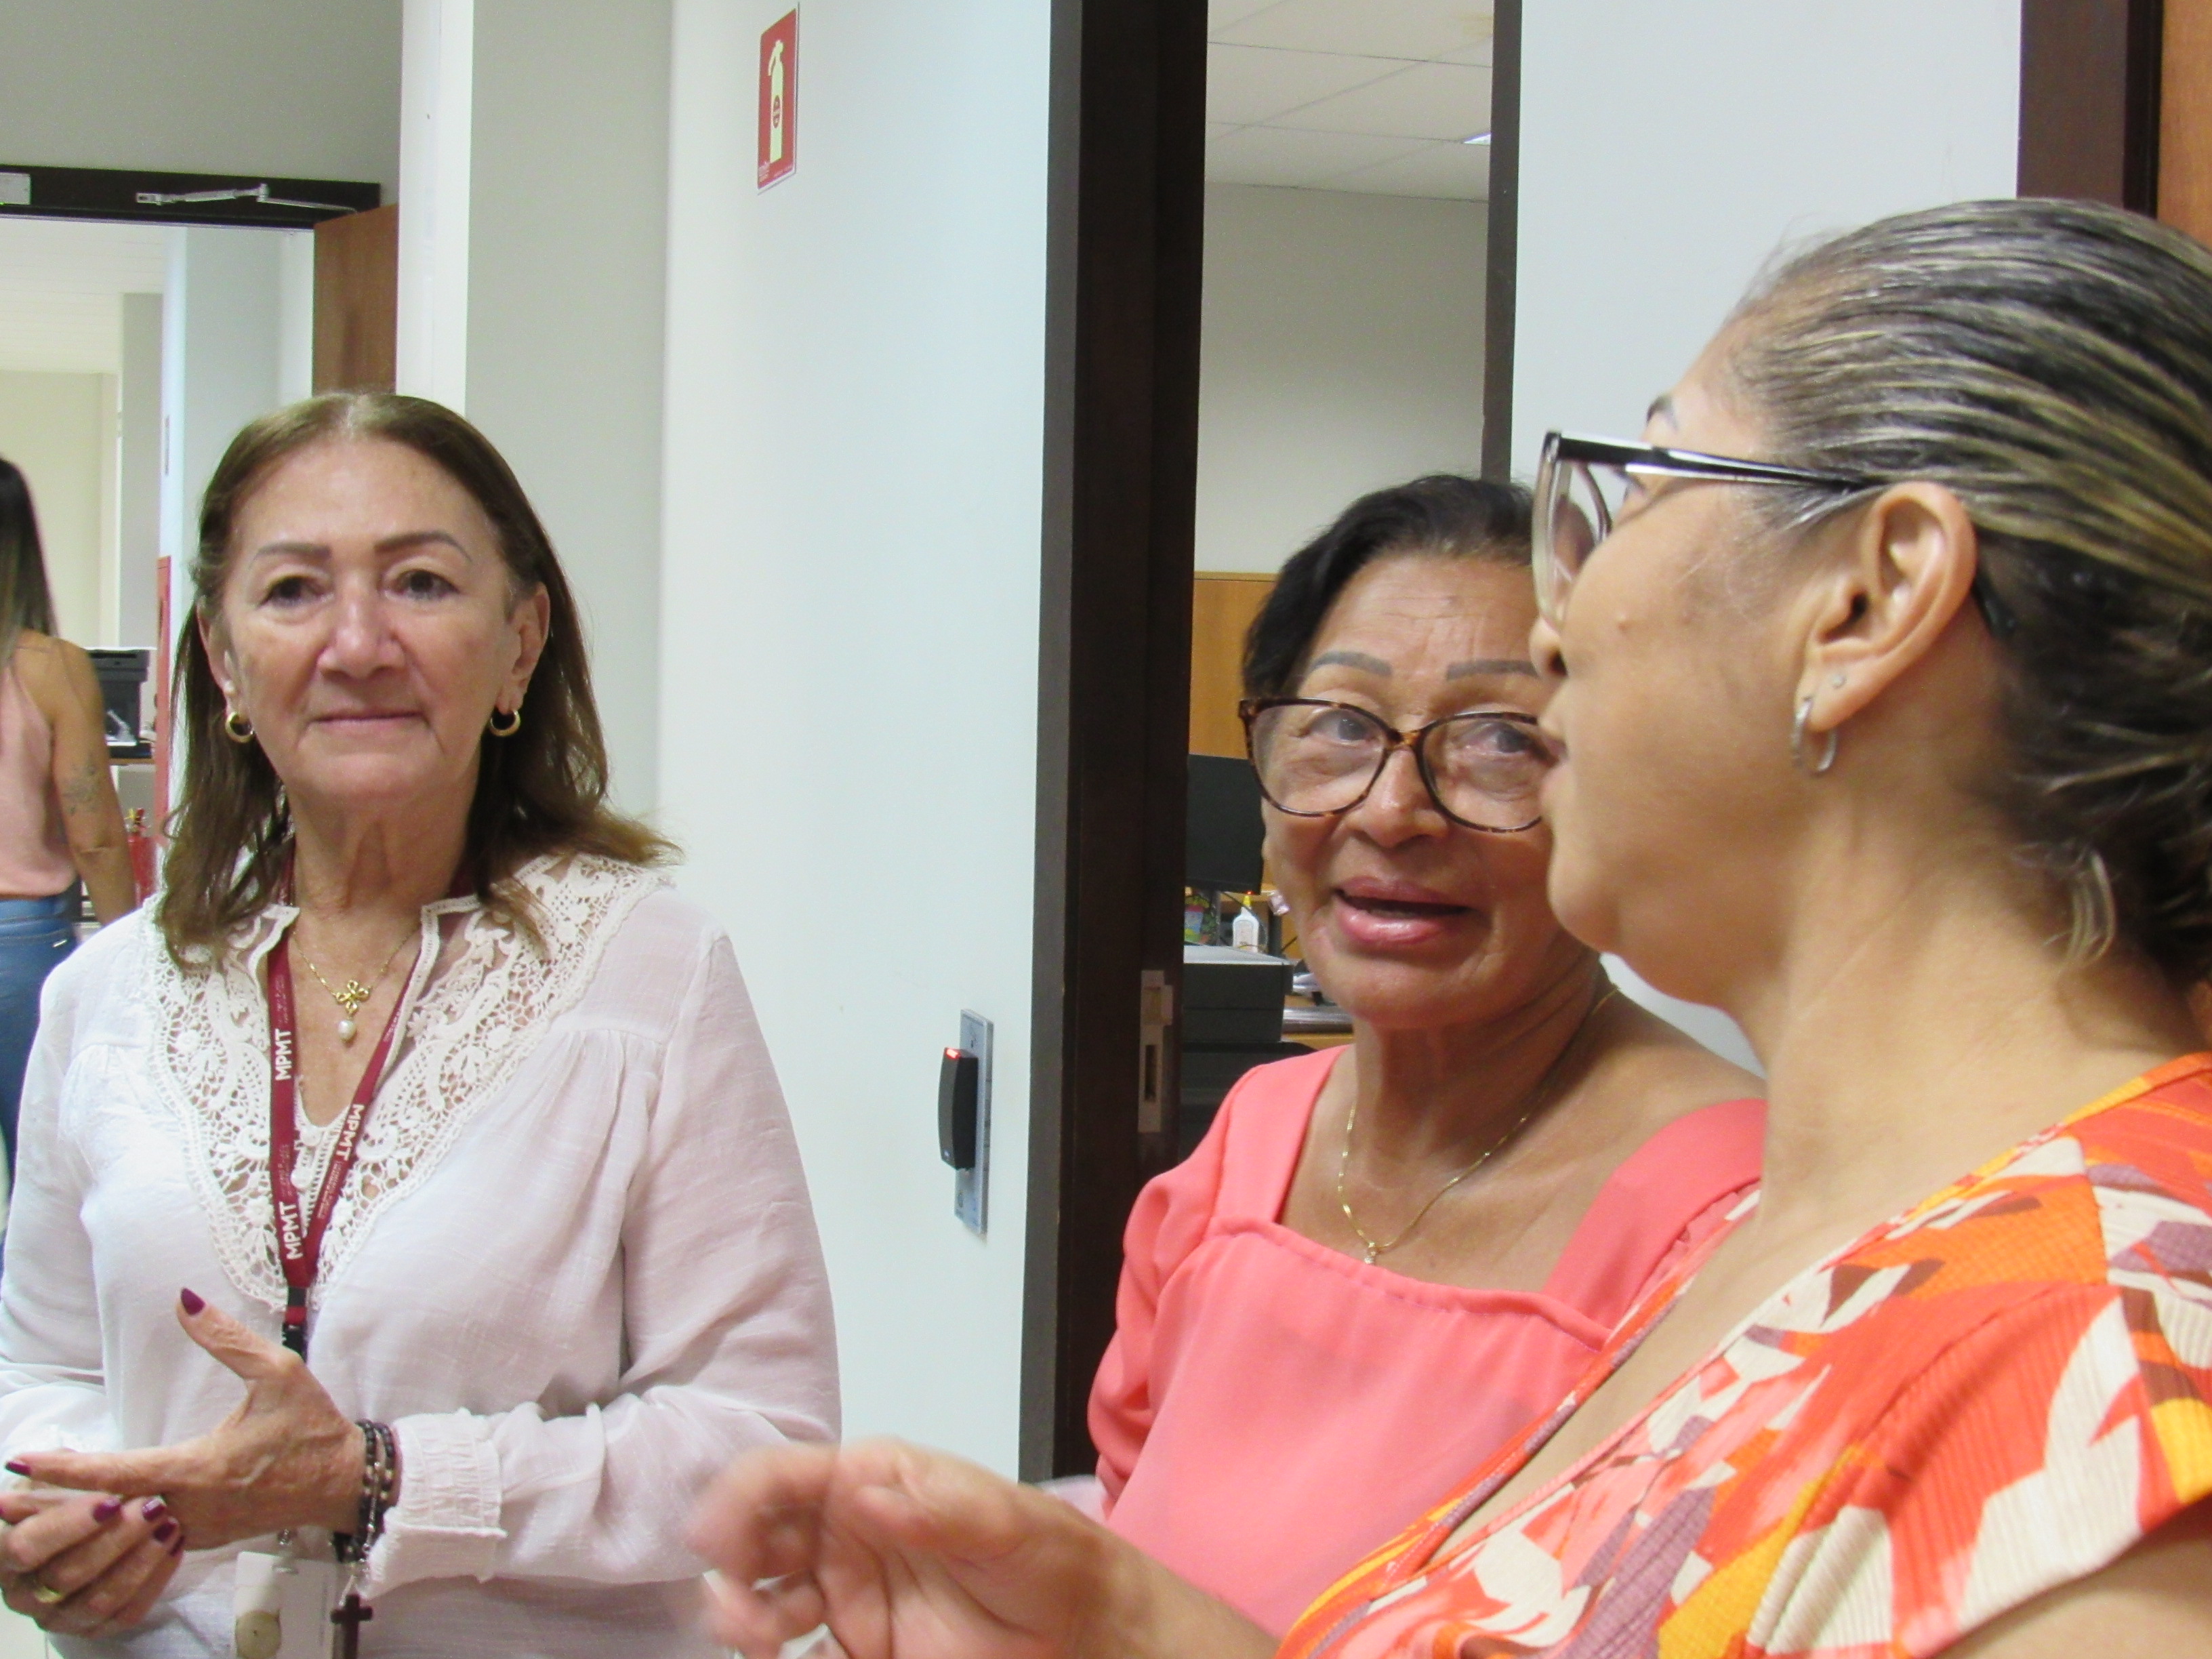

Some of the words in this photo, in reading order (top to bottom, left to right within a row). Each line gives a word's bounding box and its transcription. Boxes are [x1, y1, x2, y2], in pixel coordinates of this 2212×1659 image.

[274, 1028, 292, 1081] MPMT
[335, 1104, 365, 1161] MPMT
[279, 1201, 304, 1260] MPMT
